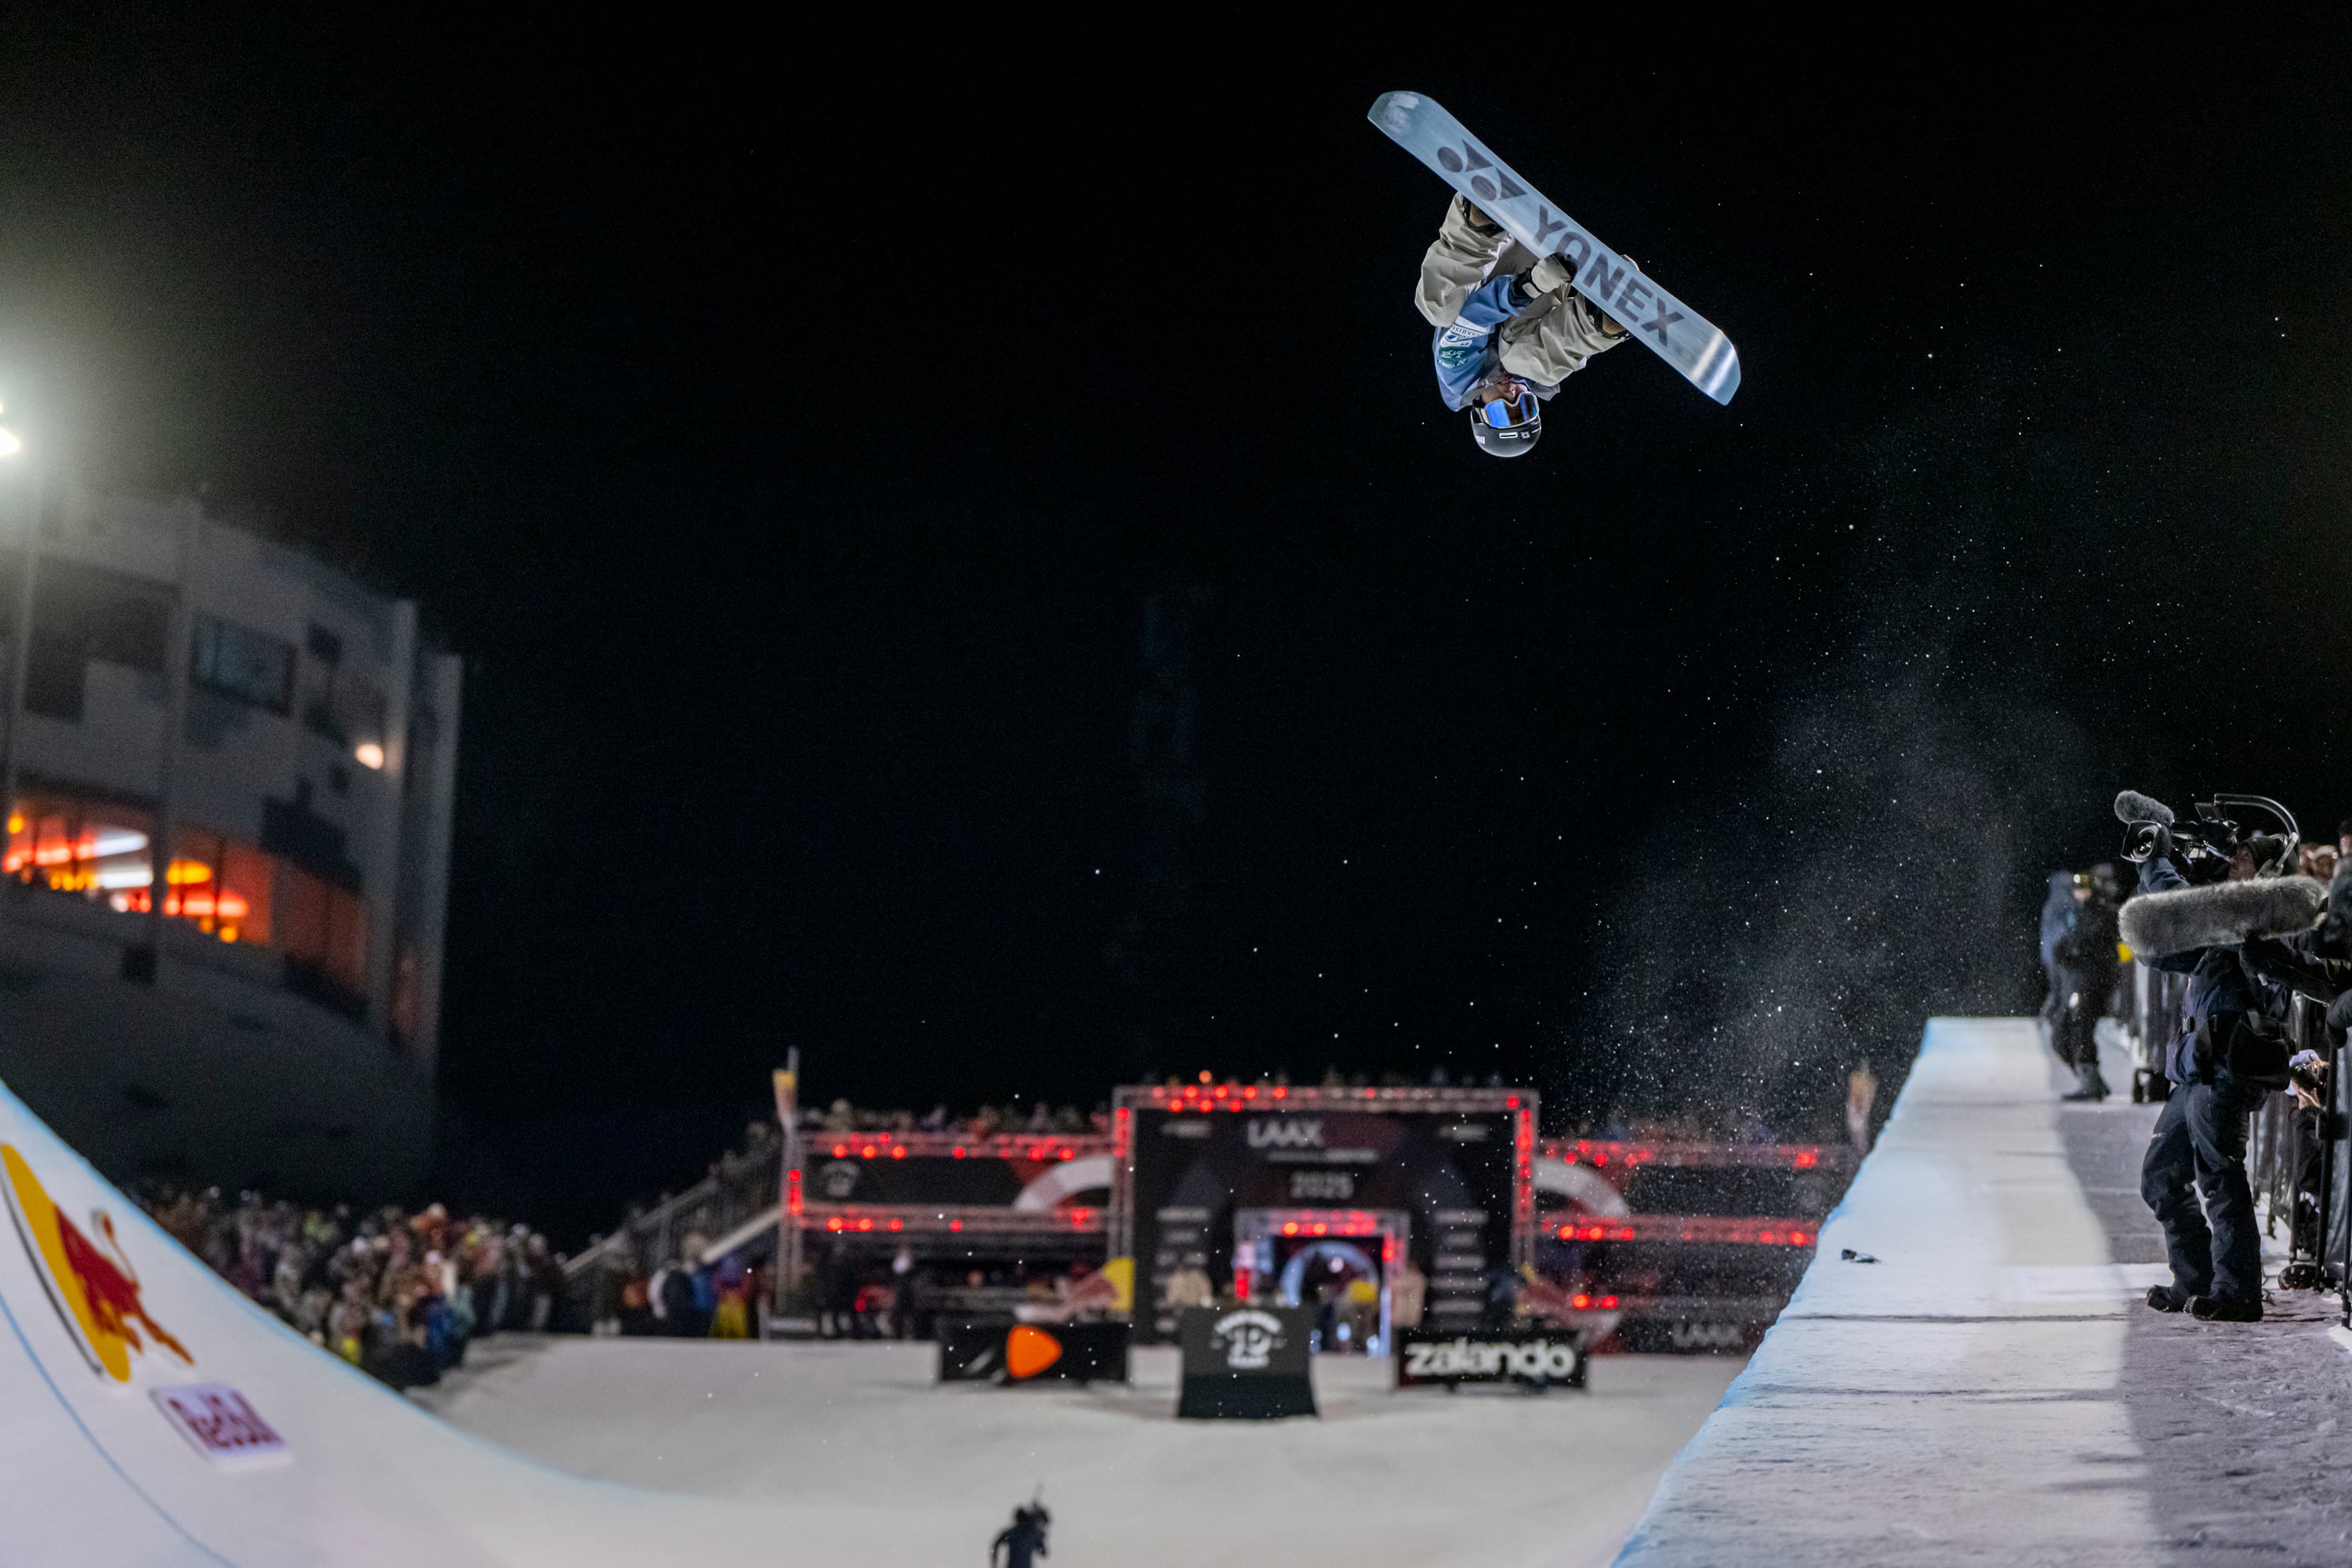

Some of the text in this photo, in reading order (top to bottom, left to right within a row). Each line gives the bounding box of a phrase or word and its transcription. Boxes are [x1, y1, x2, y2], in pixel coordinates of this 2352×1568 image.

[1533, 204, 1685, 347] YONEX
[1247, 1120, 1324, 1148] LAAX
[1404, 1336, 1576, 1379] zalando
